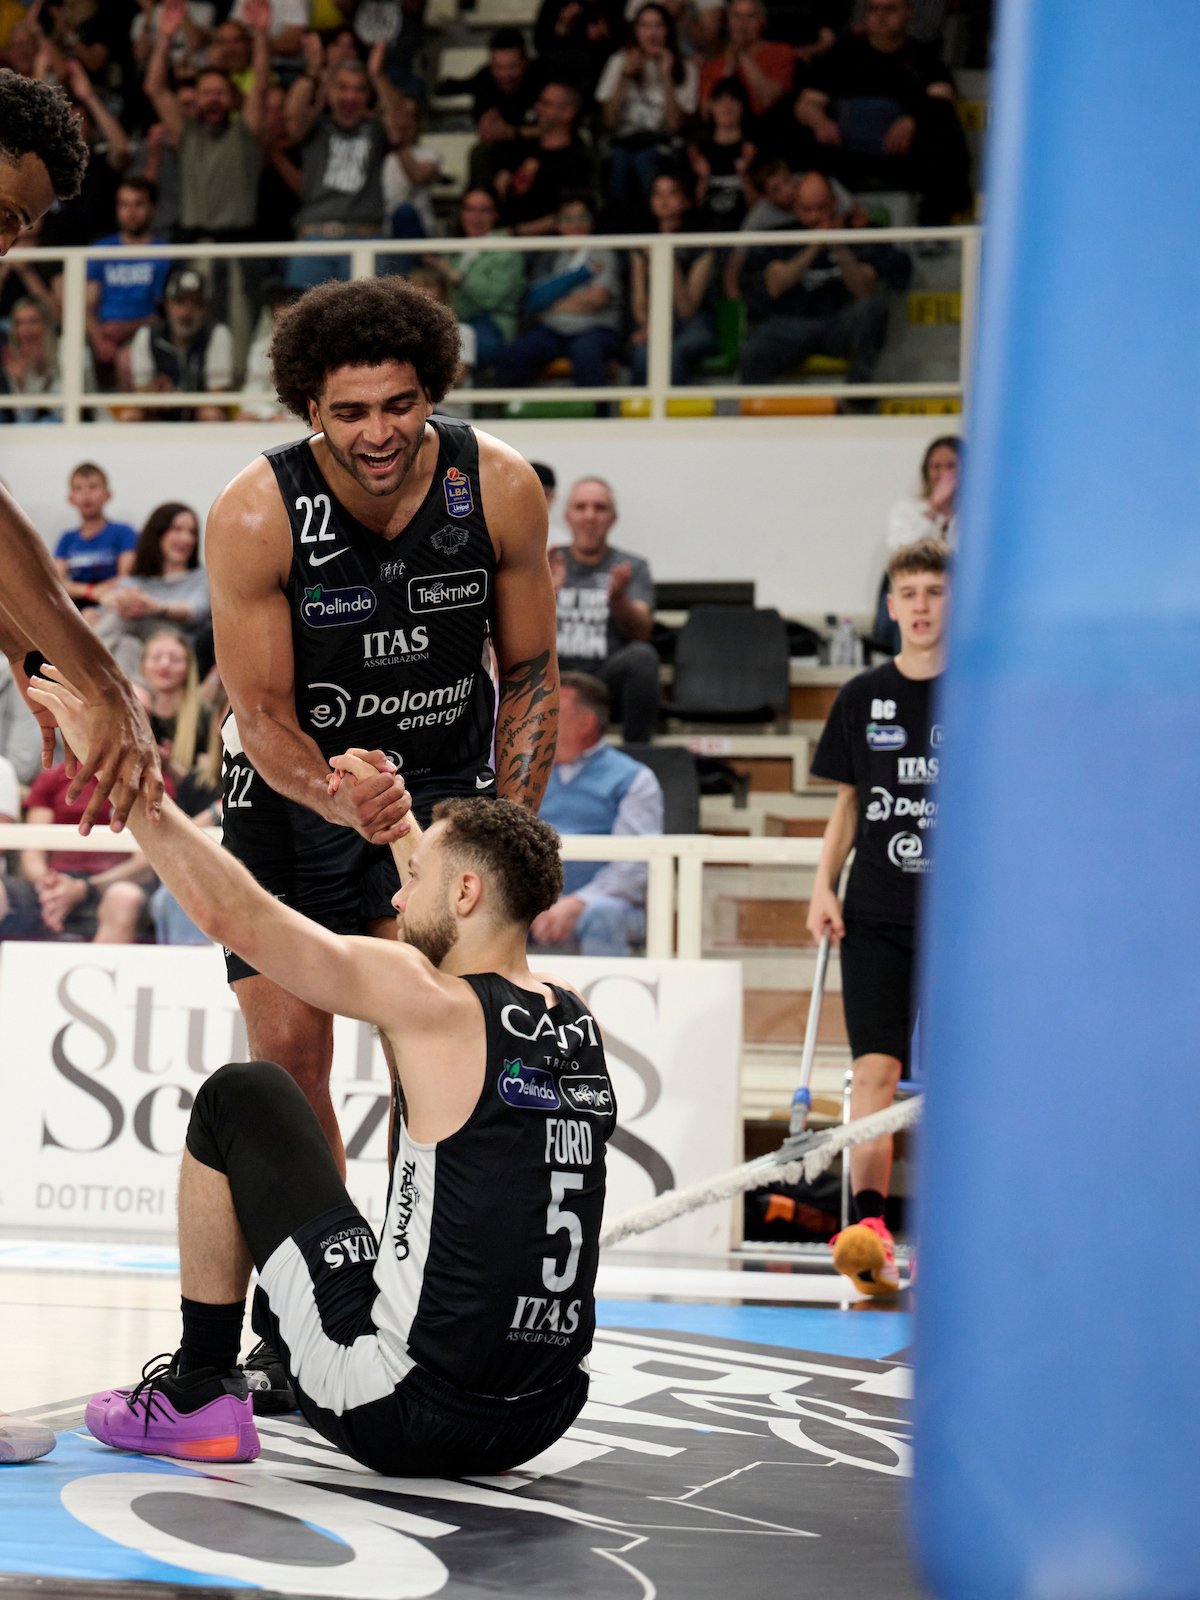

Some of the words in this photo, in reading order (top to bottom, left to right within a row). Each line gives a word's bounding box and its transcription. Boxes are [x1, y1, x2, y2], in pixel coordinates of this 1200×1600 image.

[448, 487, 468, 497] LBA
[295, 493, 337, 544] 22
[305, 594, 372, 617] Melinda
[362, 625, 430, 659] ITAS
[363, 652, 430, 668] ASSICURAZIONI
[356, 673, 475, 718] Dolomiti
[397, 701, 468, 730] energi
[402, 768, 431, 778] orate
[897, 756, 939, 778] ITAS
[227, 764, 255, 808] 22
[543, 1055, 580, 1071] TREO
[502, 1076, 557, 1101] Melinda
[544, 1117, 593, 1166] FORD
[36, 1183, 165, 1214] DOTTORI
[541, 1170, 585, 1293] 5
[324, 1235, 378, 1270] ITAS
[509, 1295, 582, 1335] ITAS
